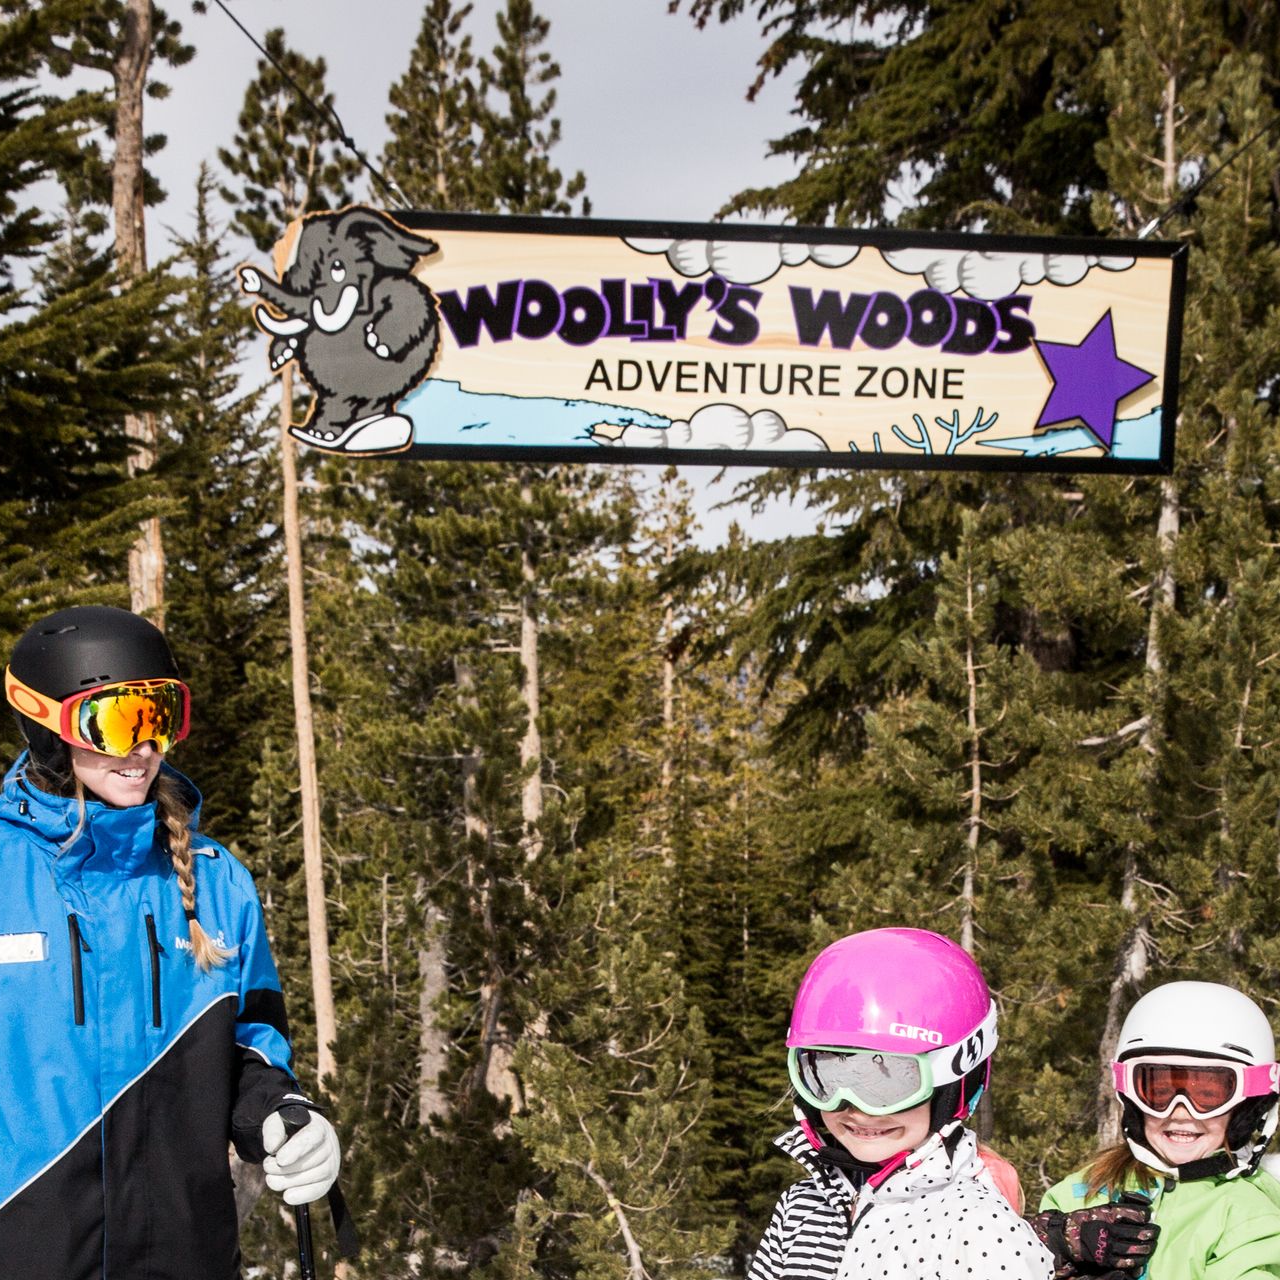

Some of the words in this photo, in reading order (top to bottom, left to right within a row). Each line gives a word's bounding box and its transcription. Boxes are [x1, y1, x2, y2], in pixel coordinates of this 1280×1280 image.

[435, 274, 764, 349] WOOLLY'S
[787, 285, 1036, 356] WOODS
[584, 358, 841, 397] ADVENTURE
[853, 365, 966, 400] ZONE
[889, 1022, 943, 1045] GIRO
